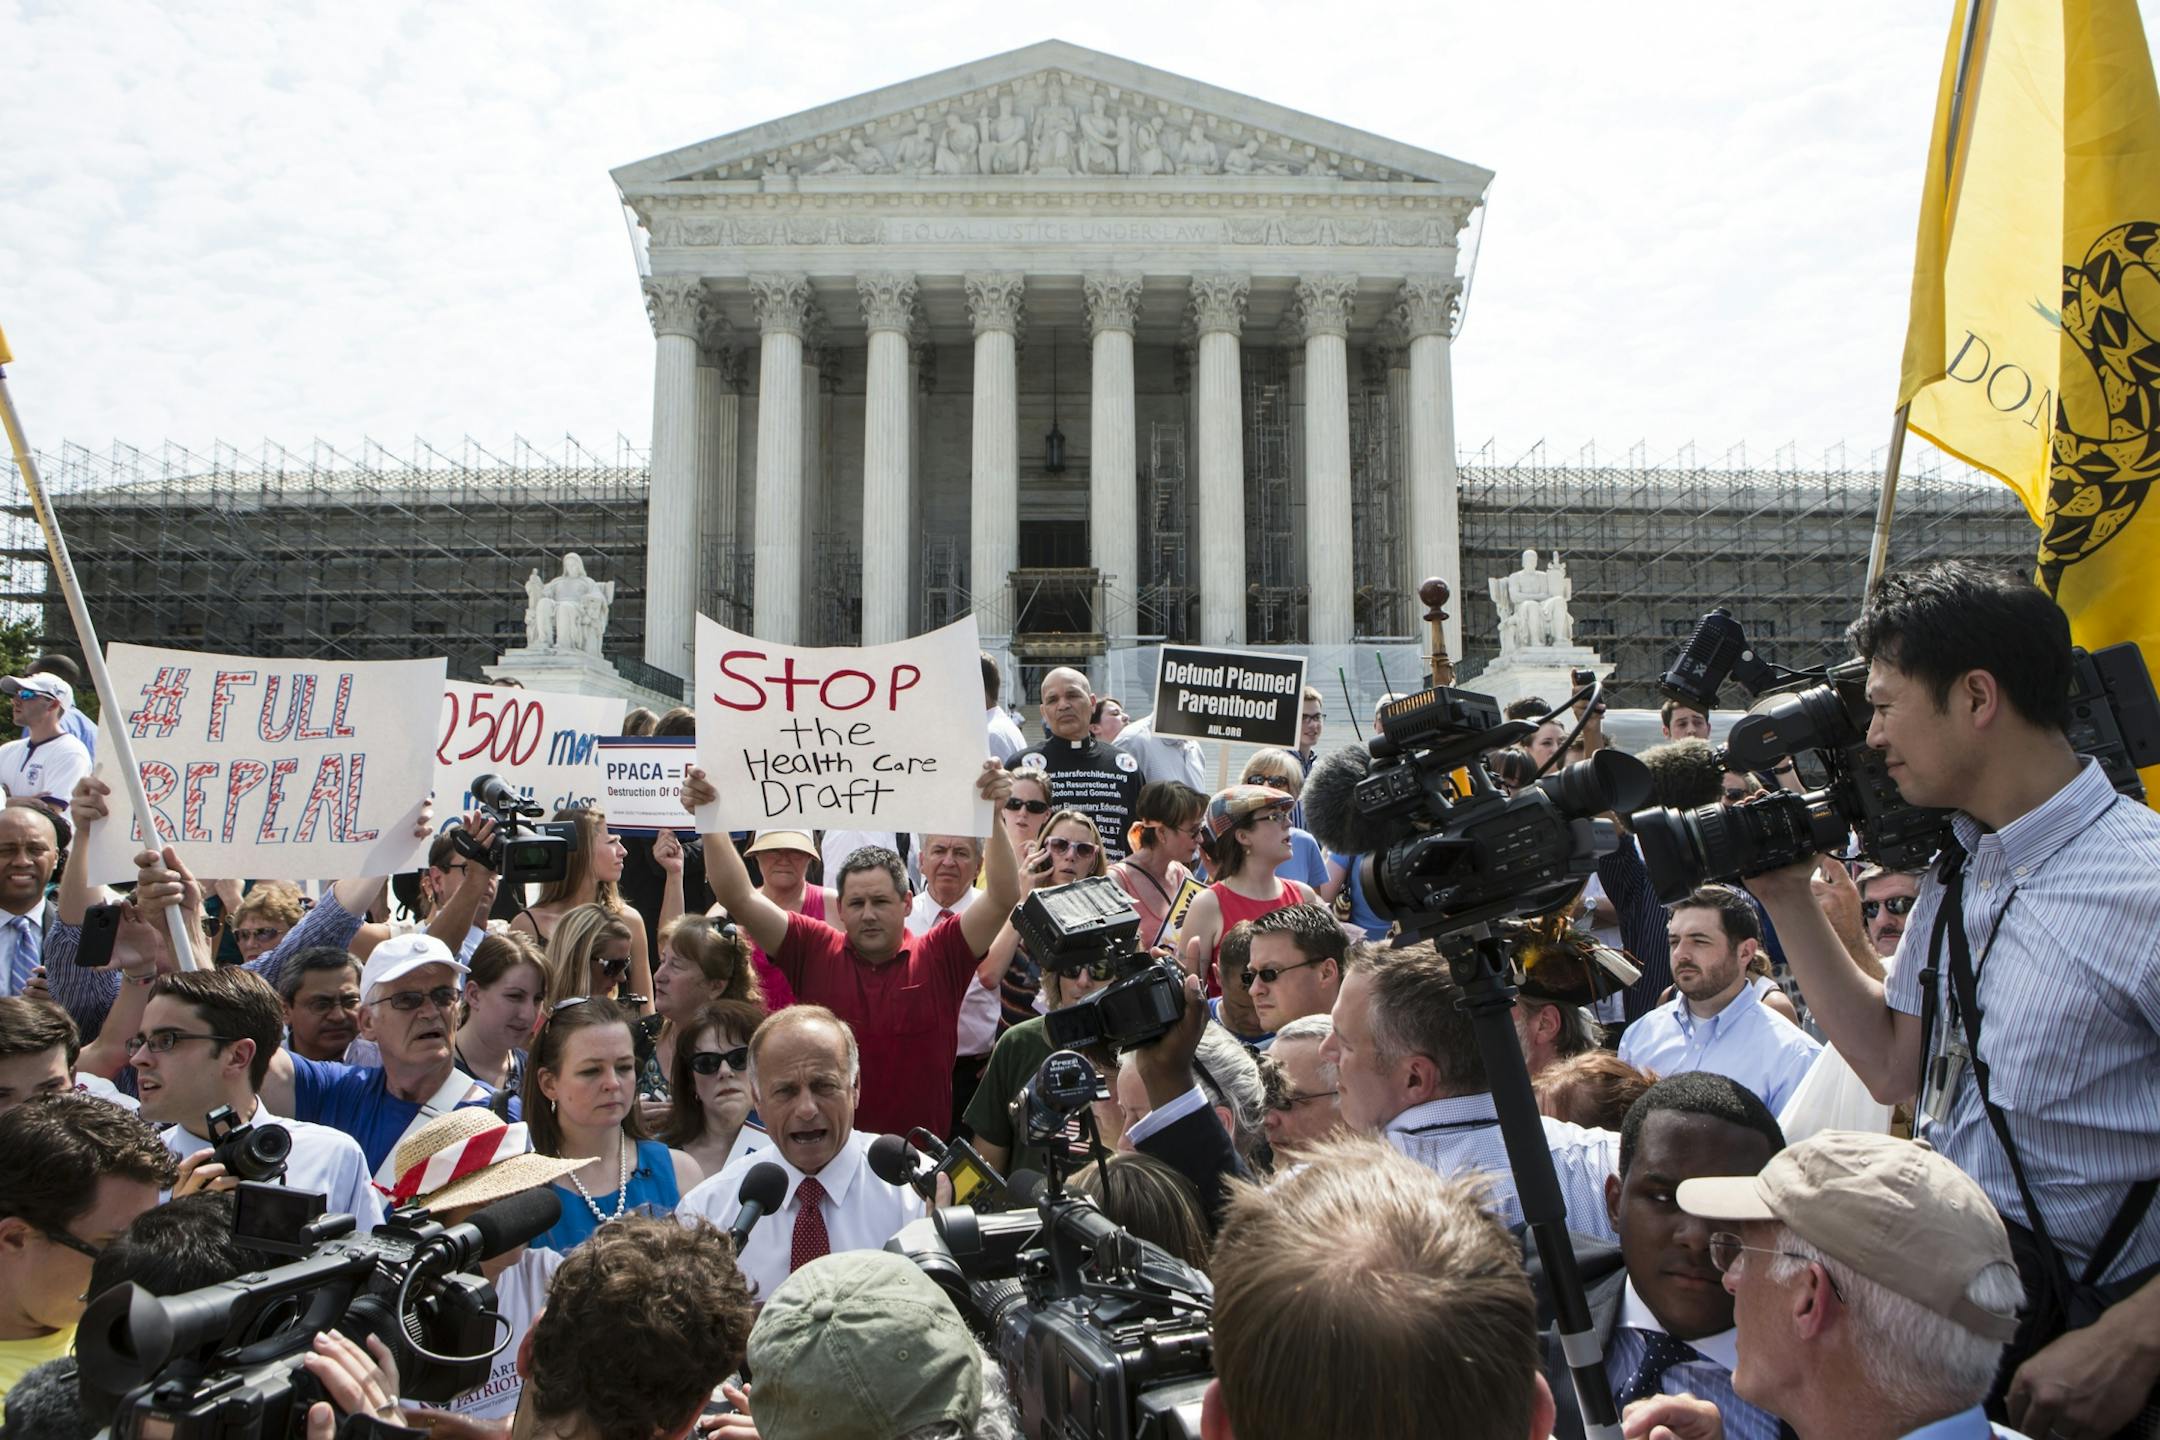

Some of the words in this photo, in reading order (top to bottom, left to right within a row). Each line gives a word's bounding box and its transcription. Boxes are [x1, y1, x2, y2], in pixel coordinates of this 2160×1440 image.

[902, 223, 976, 240] EQUAL
[984, 223, 1068, 240] JUSTICE
[1081, 223, 1152, 240] UNDER
[1164, 223, 1206, 240] LAW
[1165, 661, 1224, 688] Defund
[1225, 666, 1297, 695] Planned
[1177, 689, 1278, 721] Parenthood
[780, 717, 875, 749] the
[1207, 724, 1242, 738] AUL.ORG
[607, 762, 663, 781] PPACA
[744, 749, 853, 781] Health
[607, 786, 656, 798] Destruction
[659, 786, 669, 798] Of
[761, 778, 895, 817] Draft
[1066, 781, 1108, 789] Resurrection
[131, 753, 379, 845] REPEAL
[491, 1361, 517, 1380] ART
